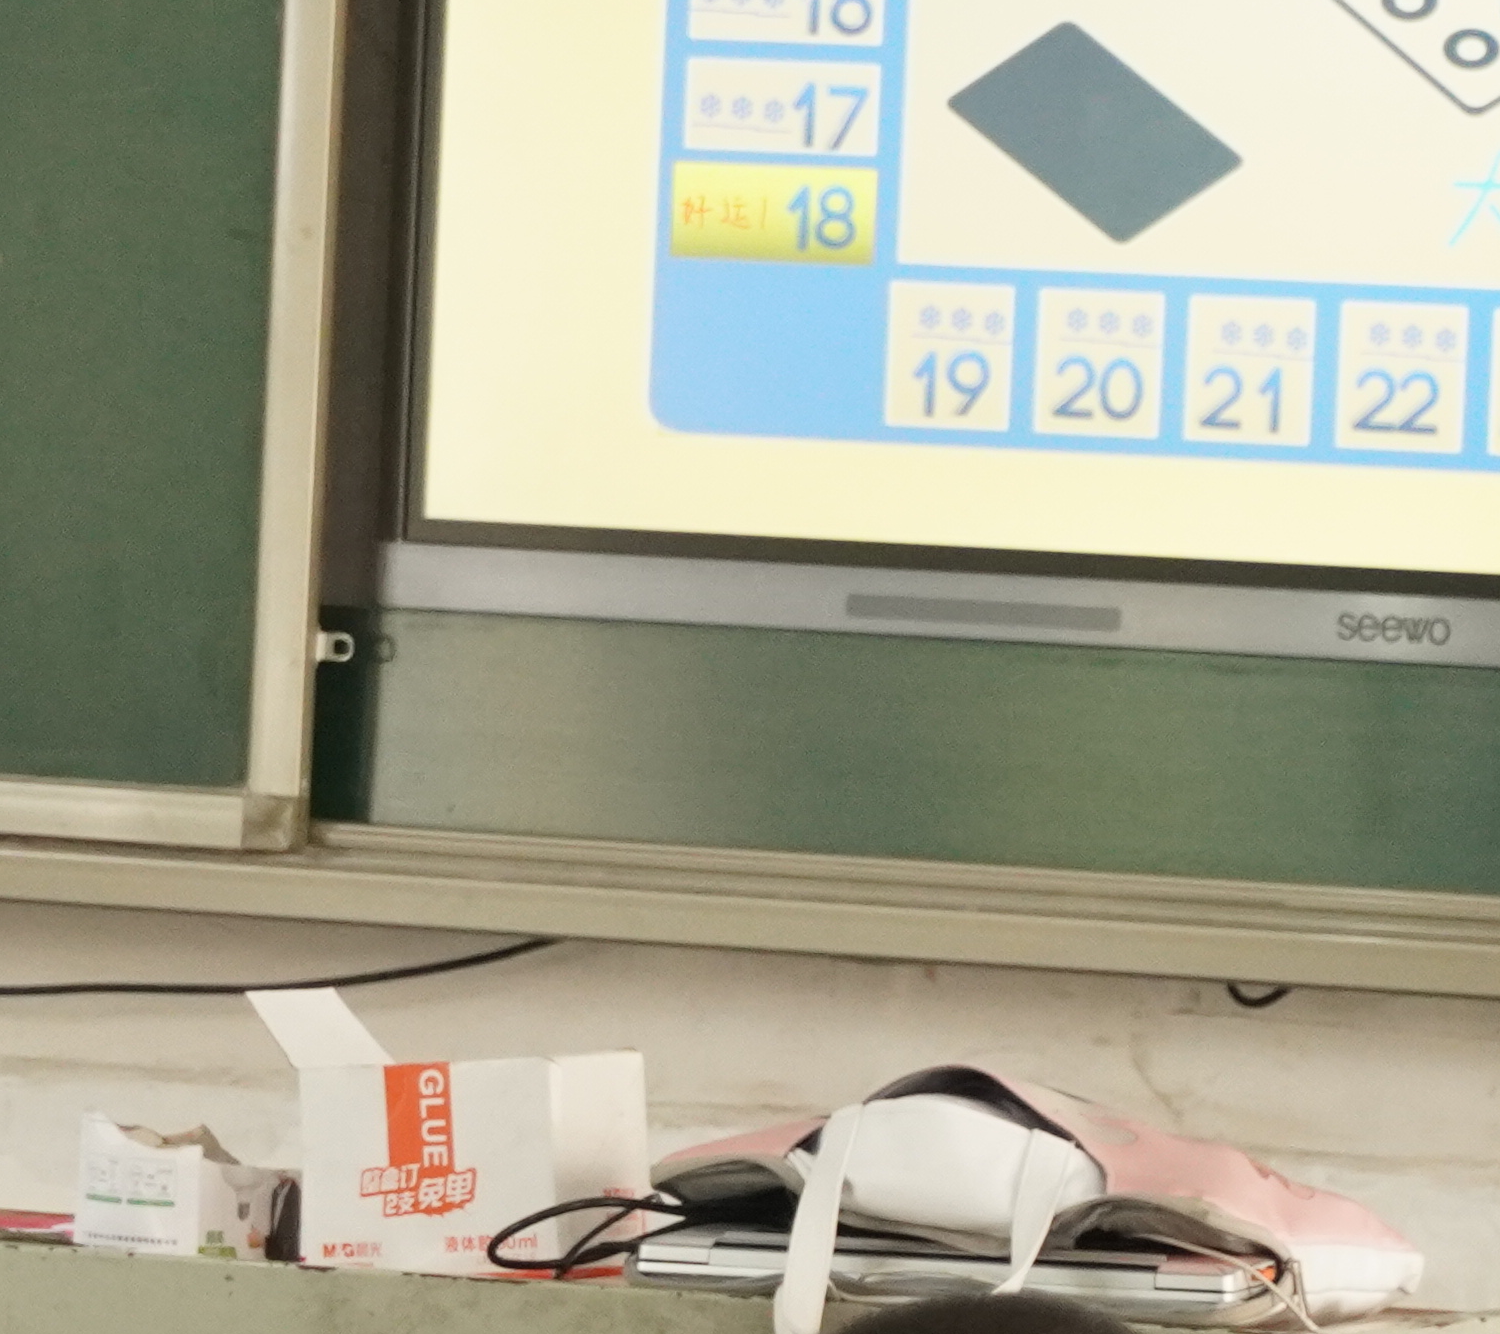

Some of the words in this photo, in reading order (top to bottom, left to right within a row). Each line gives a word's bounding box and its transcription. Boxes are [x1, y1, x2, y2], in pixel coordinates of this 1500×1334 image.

[794, 83, 869, 152] 17
[788, 185, 856, 251] 18
[914, 351, 990, 417] 19
[1052, 355, 1144, 421] 20
[1200, 365, 1282, 433] 21
[1353, 369, 1439, 435] 22
[1337, 612, 1452, 647] seewo
[418, 1068, 449, 1168] GLUE
